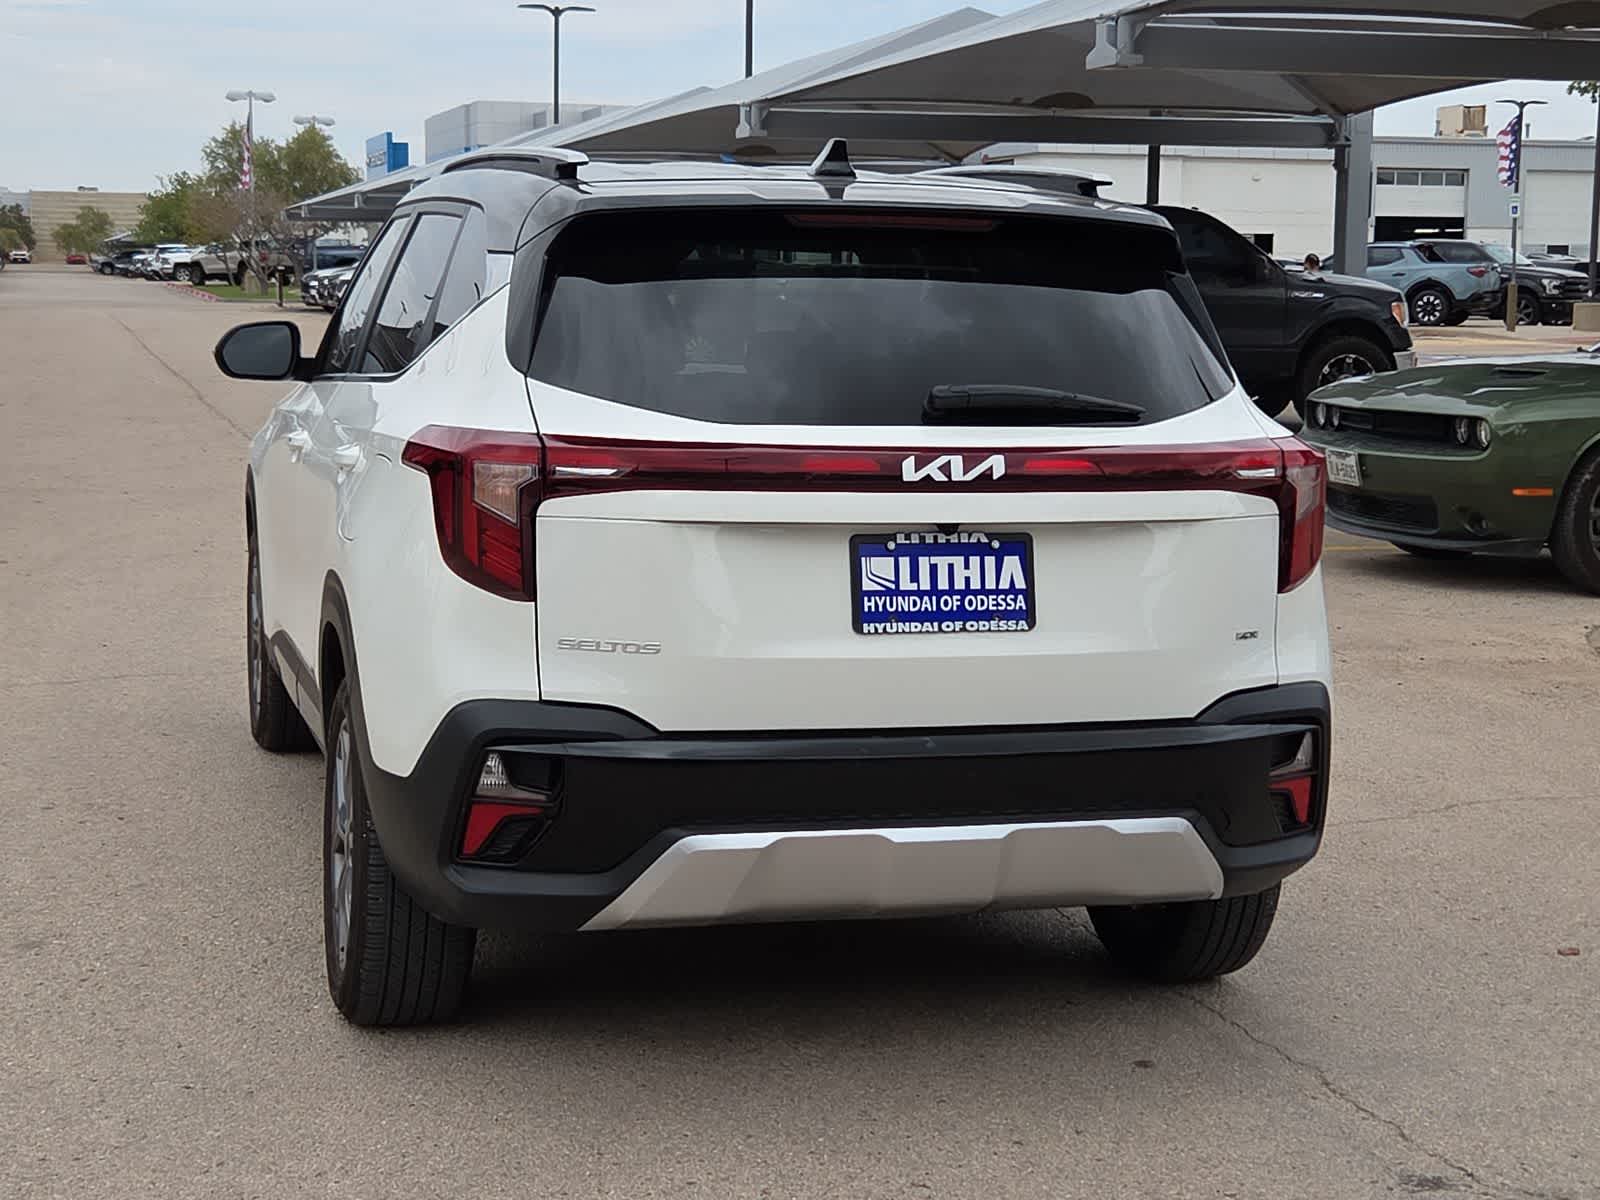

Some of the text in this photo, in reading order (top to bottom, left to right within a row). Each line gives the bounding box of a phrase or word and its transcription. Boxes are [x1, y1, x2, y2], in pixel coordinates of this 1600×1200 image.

[902, 454, 1006, 482] KIA
[896, 532, 989, 544] LITHIA
[898, 555, 1027, 590] LITHIA
[863, 595, 1027, 612] HYUNDAI OF ODESSA
[863, 619, 1029, 634] HYUNDAI OF ODESSA
[557, 637, 661, 655] SELTOS
